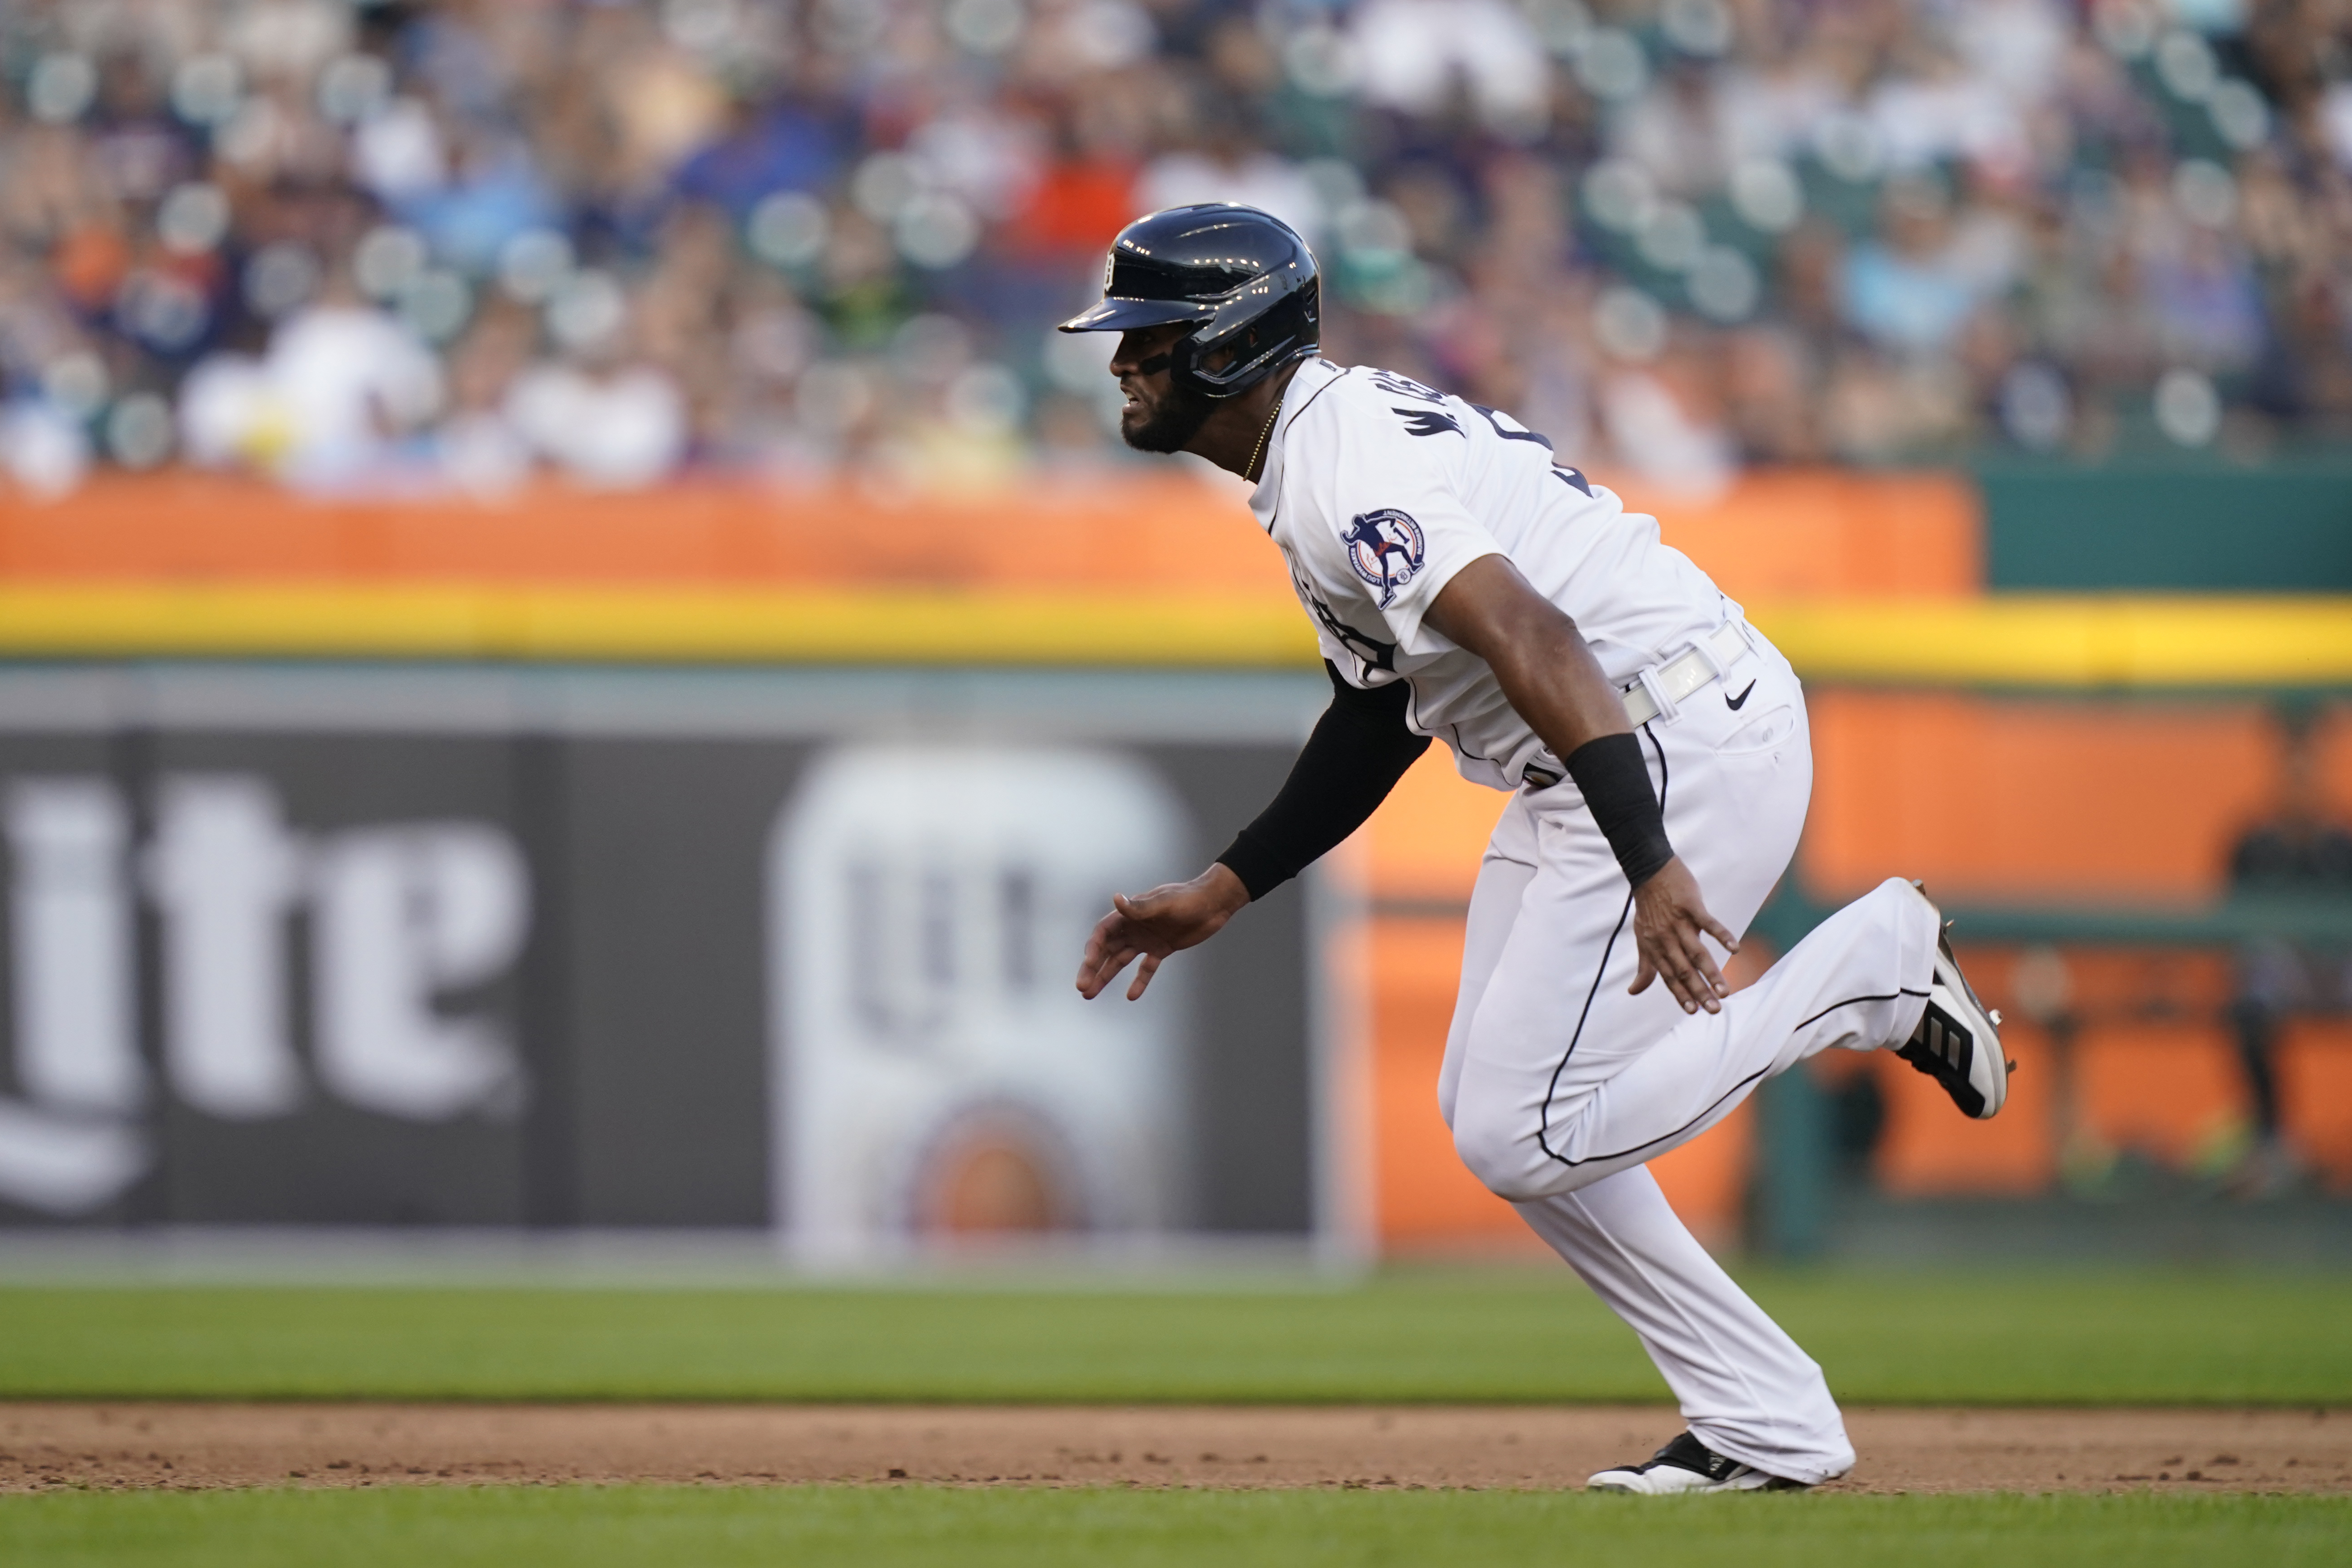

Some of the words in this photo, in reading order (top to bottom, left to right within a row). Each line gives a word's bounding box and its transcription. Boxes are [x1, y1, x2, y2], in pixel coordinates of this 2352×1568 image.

[1393, 527, 1410, 544] 1
[1350, 547, 1368, 580] WHITAKER
[1367, 575, 1380, 584] LOU
[0, 770, 537, 1214] ite
